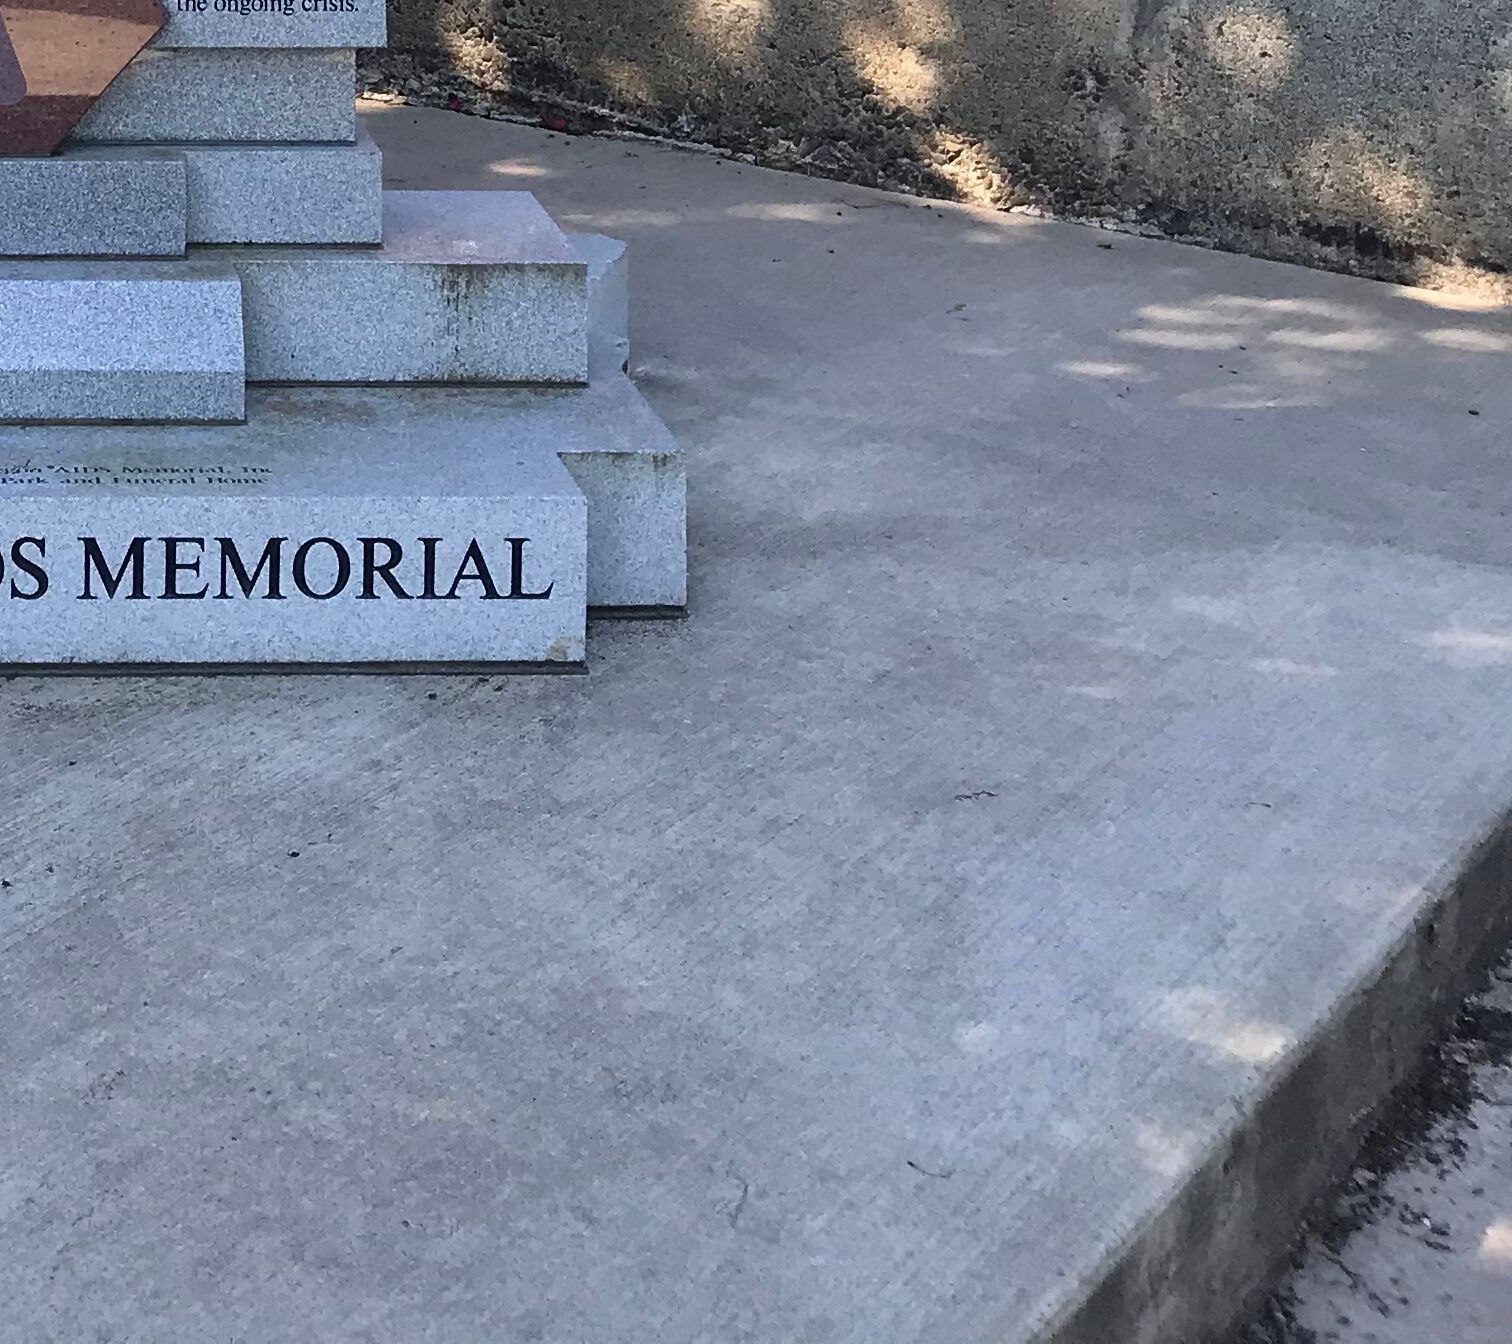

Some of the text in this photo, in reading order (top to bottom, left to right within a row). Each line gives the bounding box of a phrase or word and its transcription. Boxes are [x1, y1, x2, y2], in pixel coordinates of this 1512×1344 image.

[53, 466, 112, 474] AIDS
[0, 476, 49, 485] Park
[59, 476, 101, 485] and
[112, 476, 197, 485] Funeral
[206, 477, 269, 485] Home
[77, 537, 554, 600] MEMORIAL
